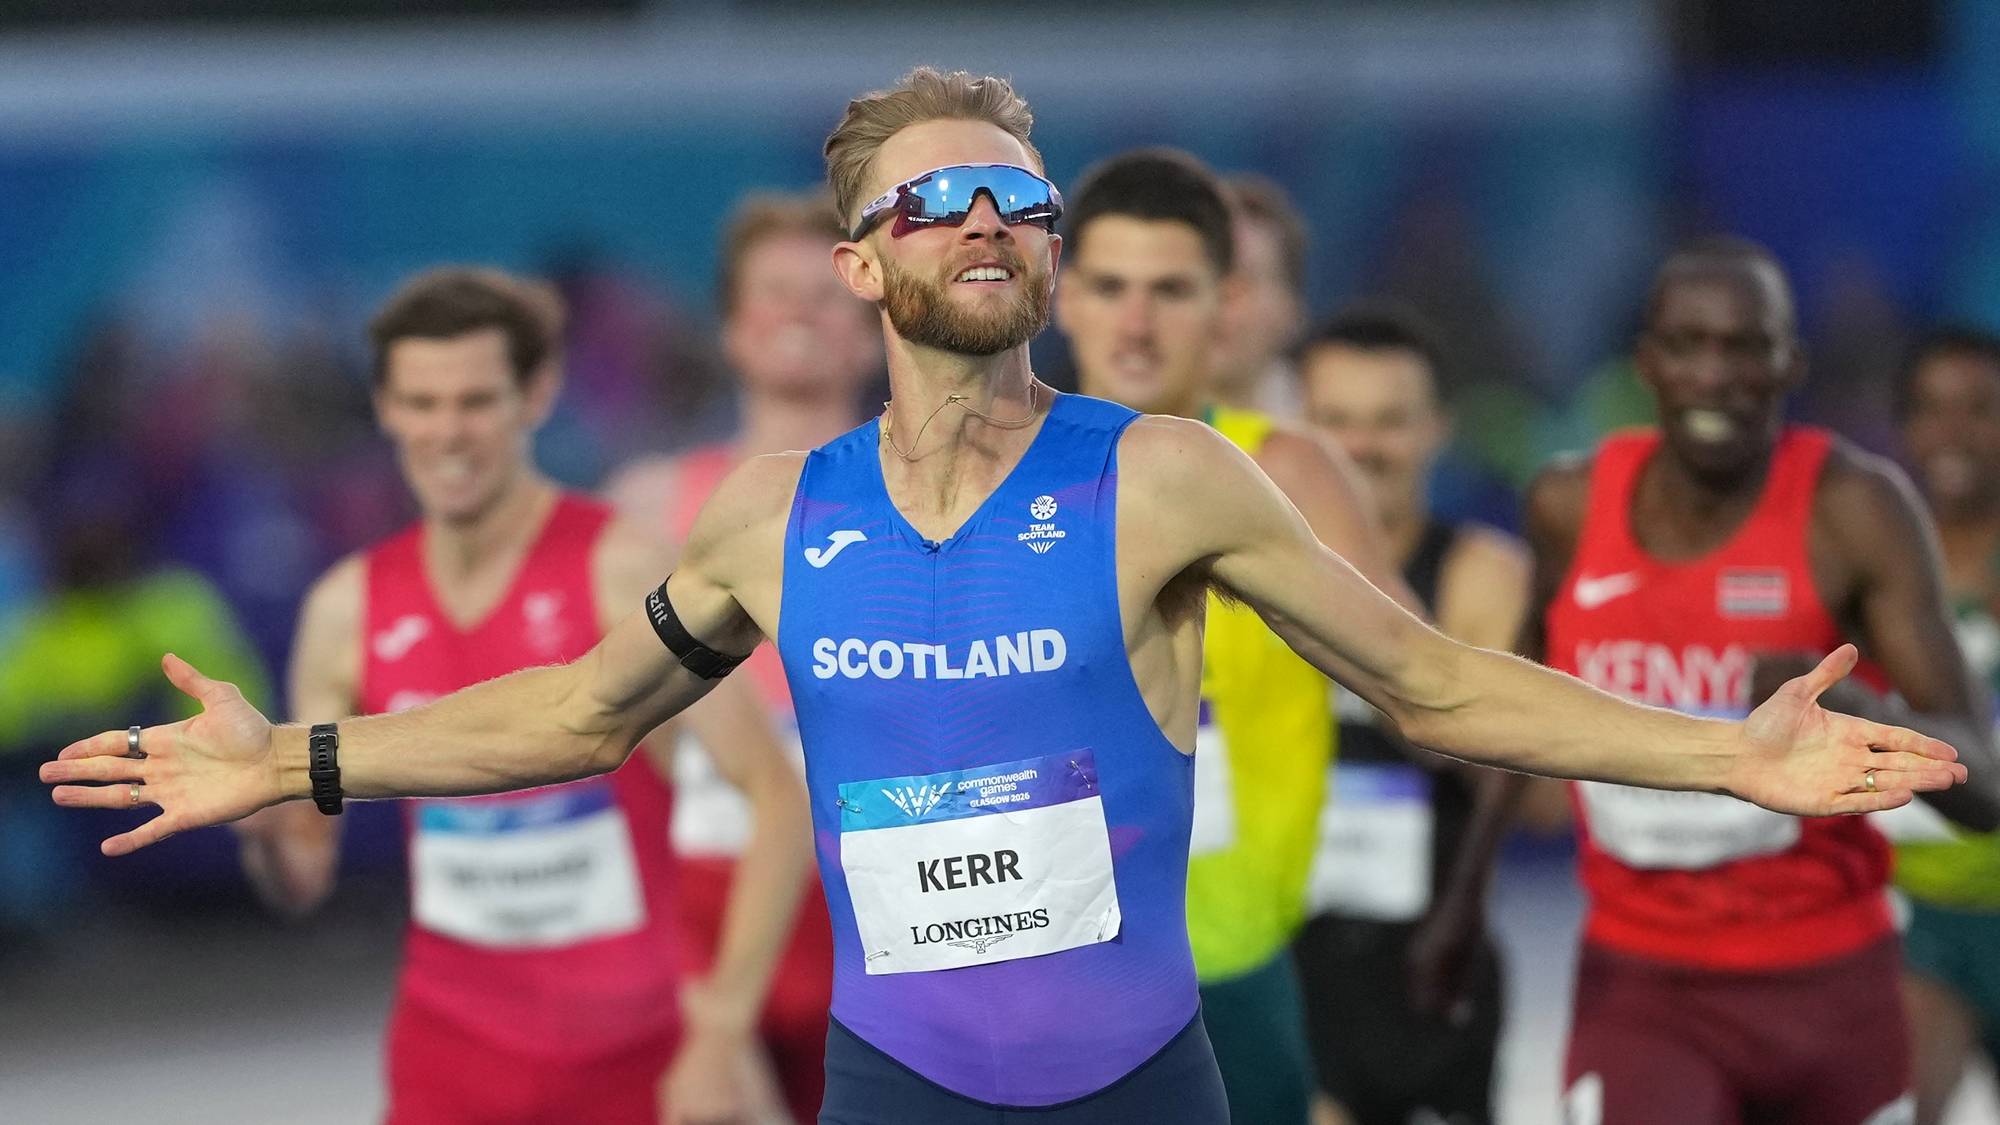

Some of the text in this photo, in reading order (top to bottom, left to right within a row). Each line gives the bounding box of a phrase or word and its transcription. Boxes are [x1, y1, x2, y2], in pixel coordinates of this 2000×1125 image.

[1017, 530, 1066, 541] SCOTLAND
[1030, 523, 1056, 532] TEAM
[812, 628, 1067, 680] SCOTLAND
[1575, 639, 1757, 708] KENY
[957, 769, 1038, 791] commonwealth
[980, 781, 1018, 797] games
[969, 792, 1031, 808] GLASGOW 2026
[917, 849, 1023, 893] KERR
[910, 908, 1050, 945] LONGINES
